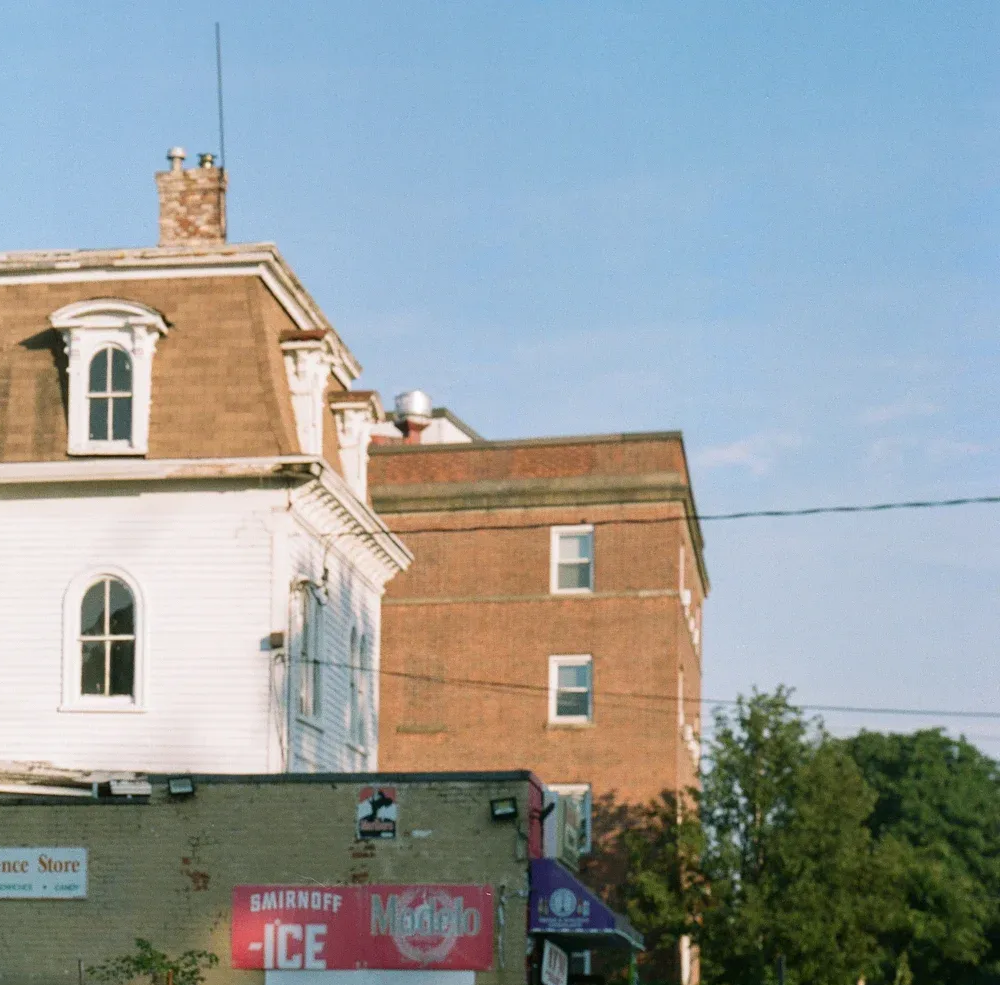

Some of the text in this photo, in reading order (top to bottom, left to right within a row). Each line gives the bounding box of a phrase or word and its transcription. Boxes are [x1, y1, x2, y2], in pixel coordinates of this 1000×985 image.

[38, 853, 80, 874] Store
[250, 890, 343, 914] SMIRNOFF
[370, 893, 481, 937] Modelo
[263, 922, 328, 970] ICE
